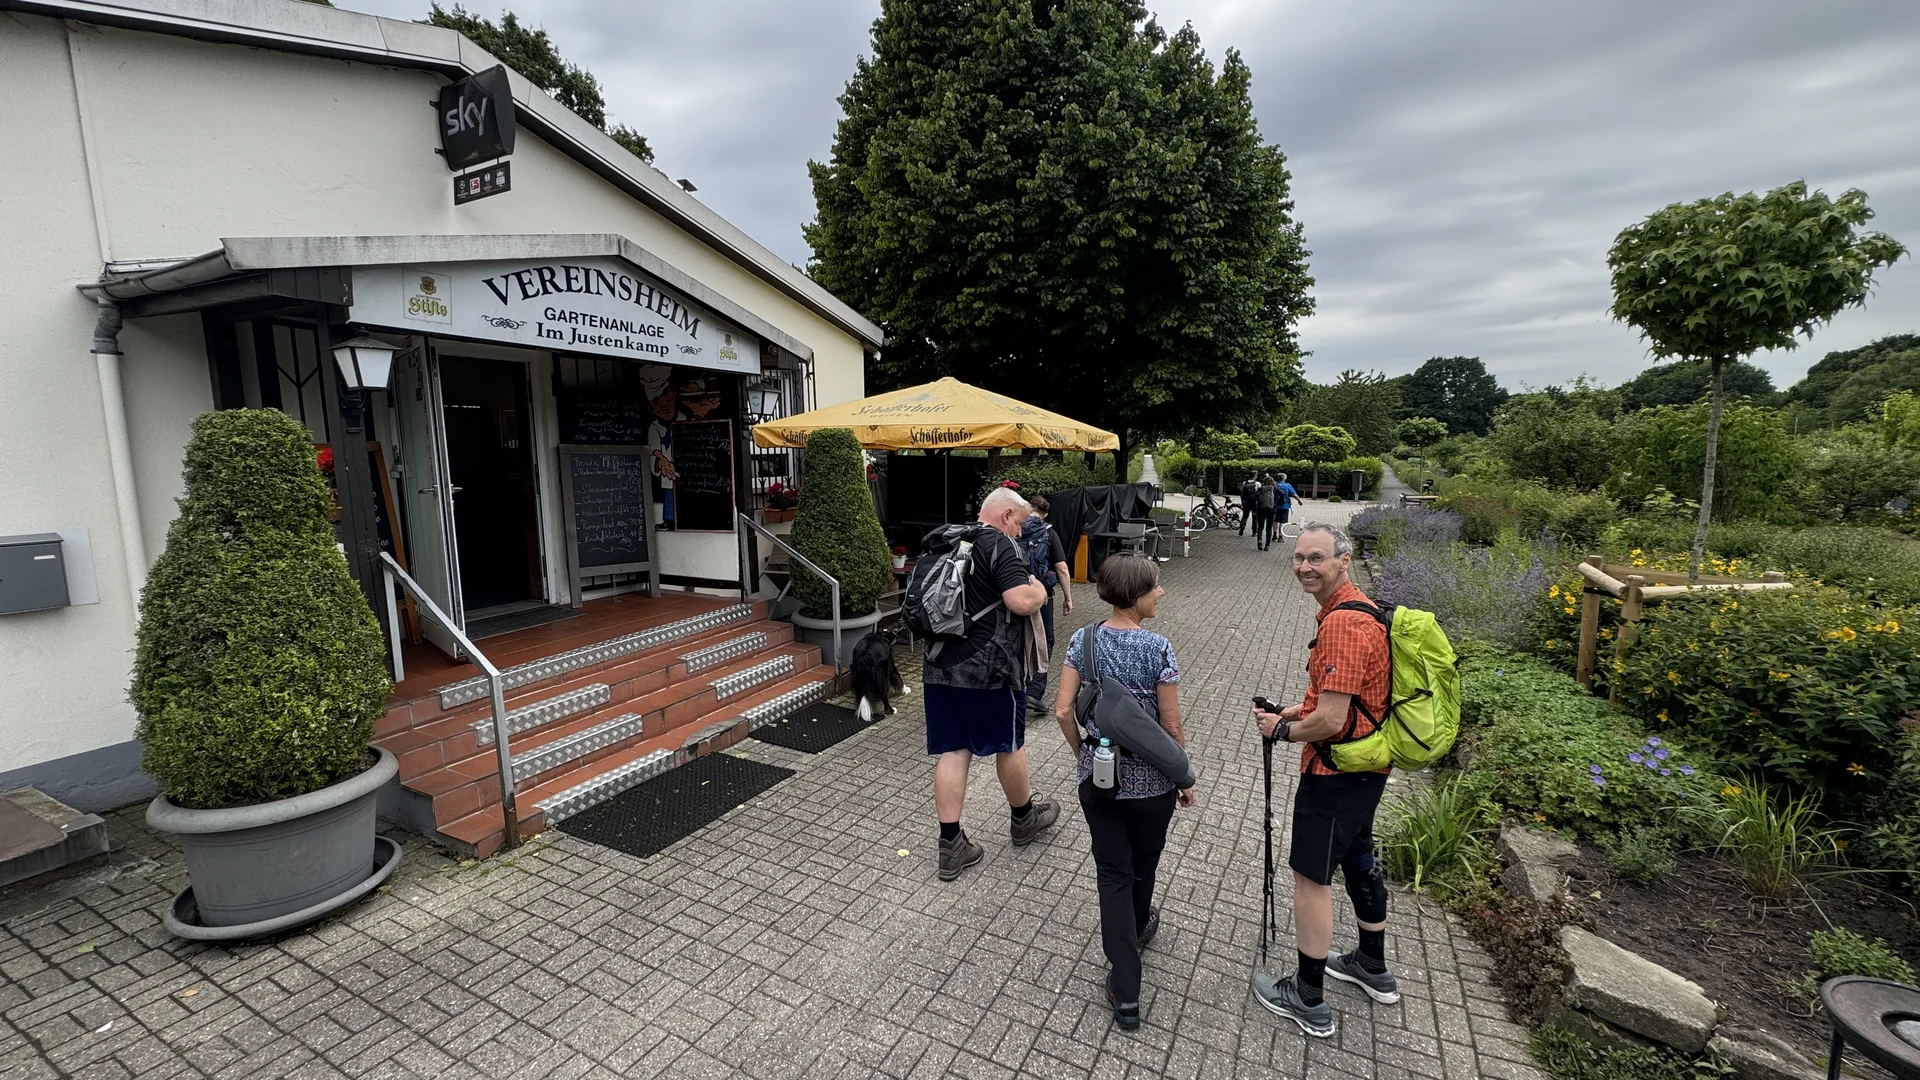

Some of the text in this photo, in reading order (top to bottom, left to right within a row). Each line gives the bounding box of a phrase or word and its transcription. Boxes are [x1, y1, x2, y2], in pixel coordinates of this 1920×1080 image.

[446, 95, 488, 137] sky
[408, 296, 448, 317] Stifts
[481, 265, 701, 340] VEREINSHEIM
[535, 321, 670, 358] Im Justenkamp
[544, 306, 665, 339] GARTENANLAGE
[909, 425, 974, 445] Schöfferhofer
